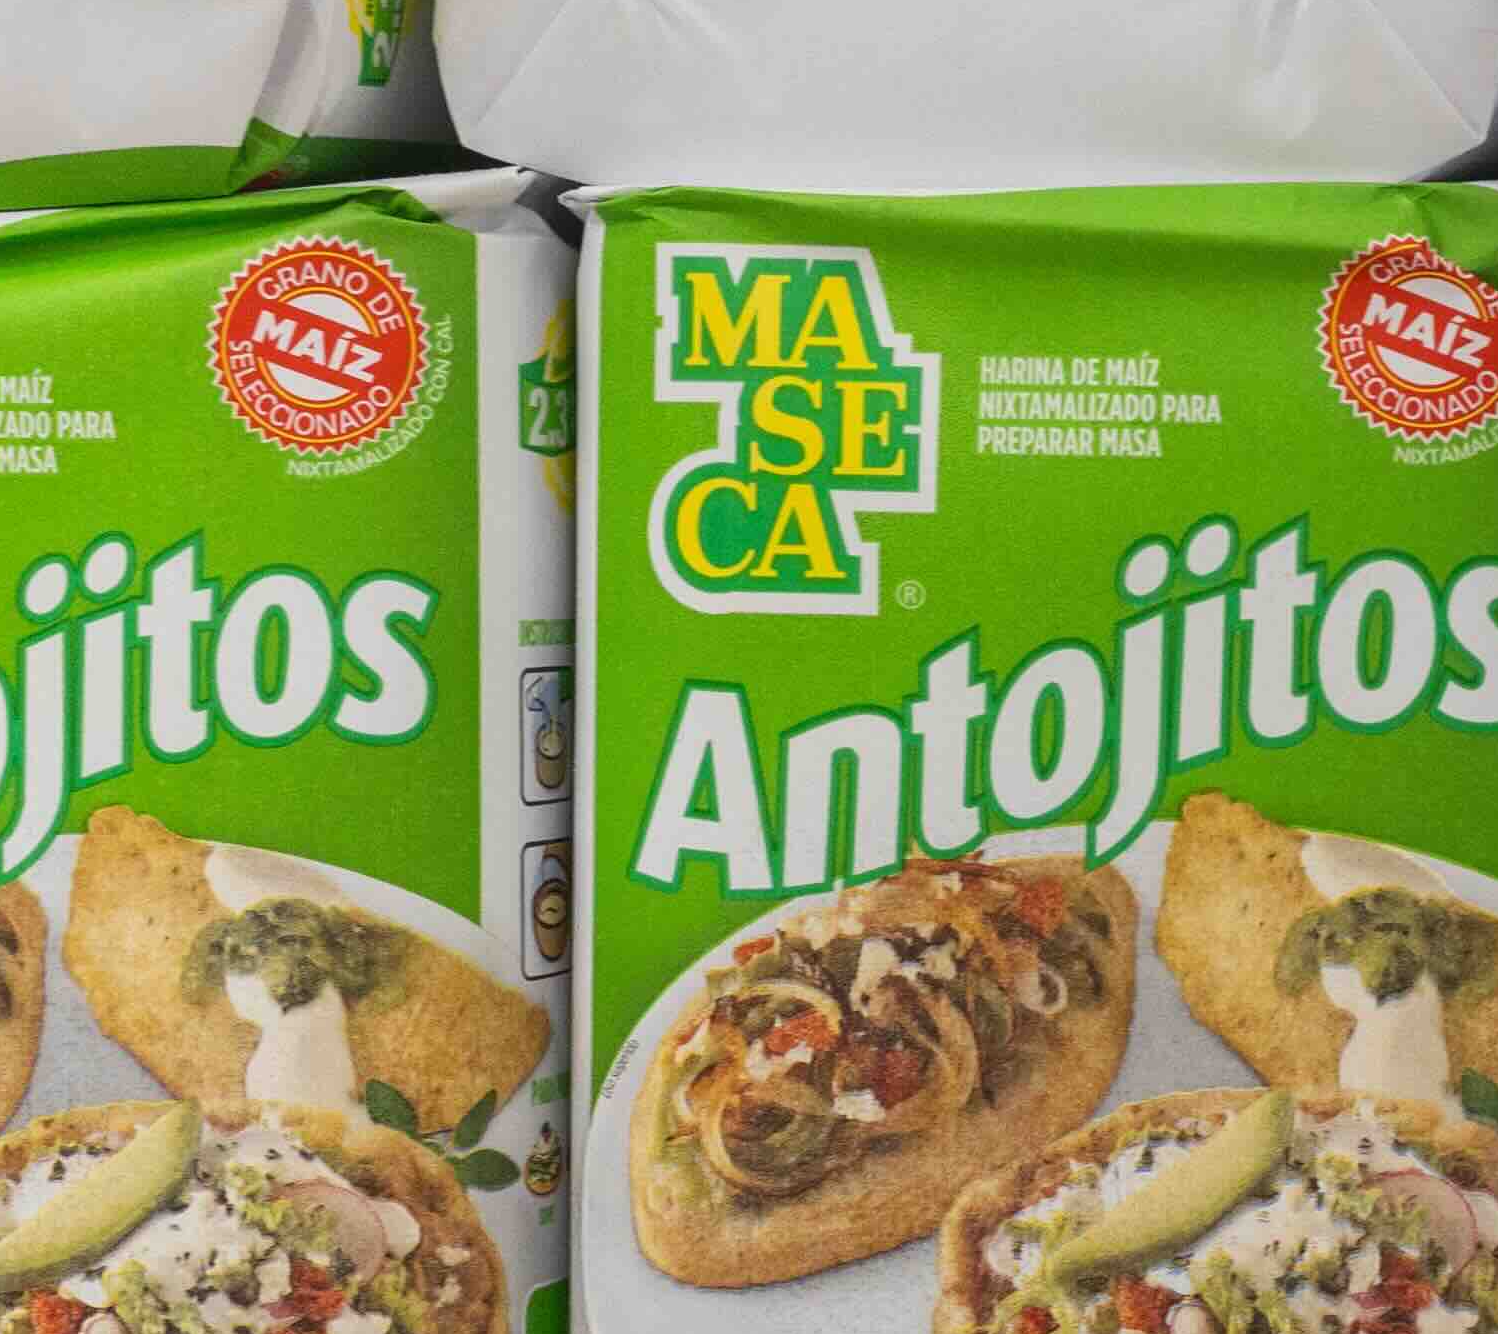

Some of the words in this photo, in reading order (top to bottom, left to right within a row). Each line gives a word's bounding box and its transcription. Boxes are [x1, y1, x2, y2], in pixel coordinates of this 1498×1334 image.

[685, 270, 875, 371] MA
[56, 410, 117, 439] PARA
[749, 377, 907, 478] SE
[676, 478, 846, 579] CA
